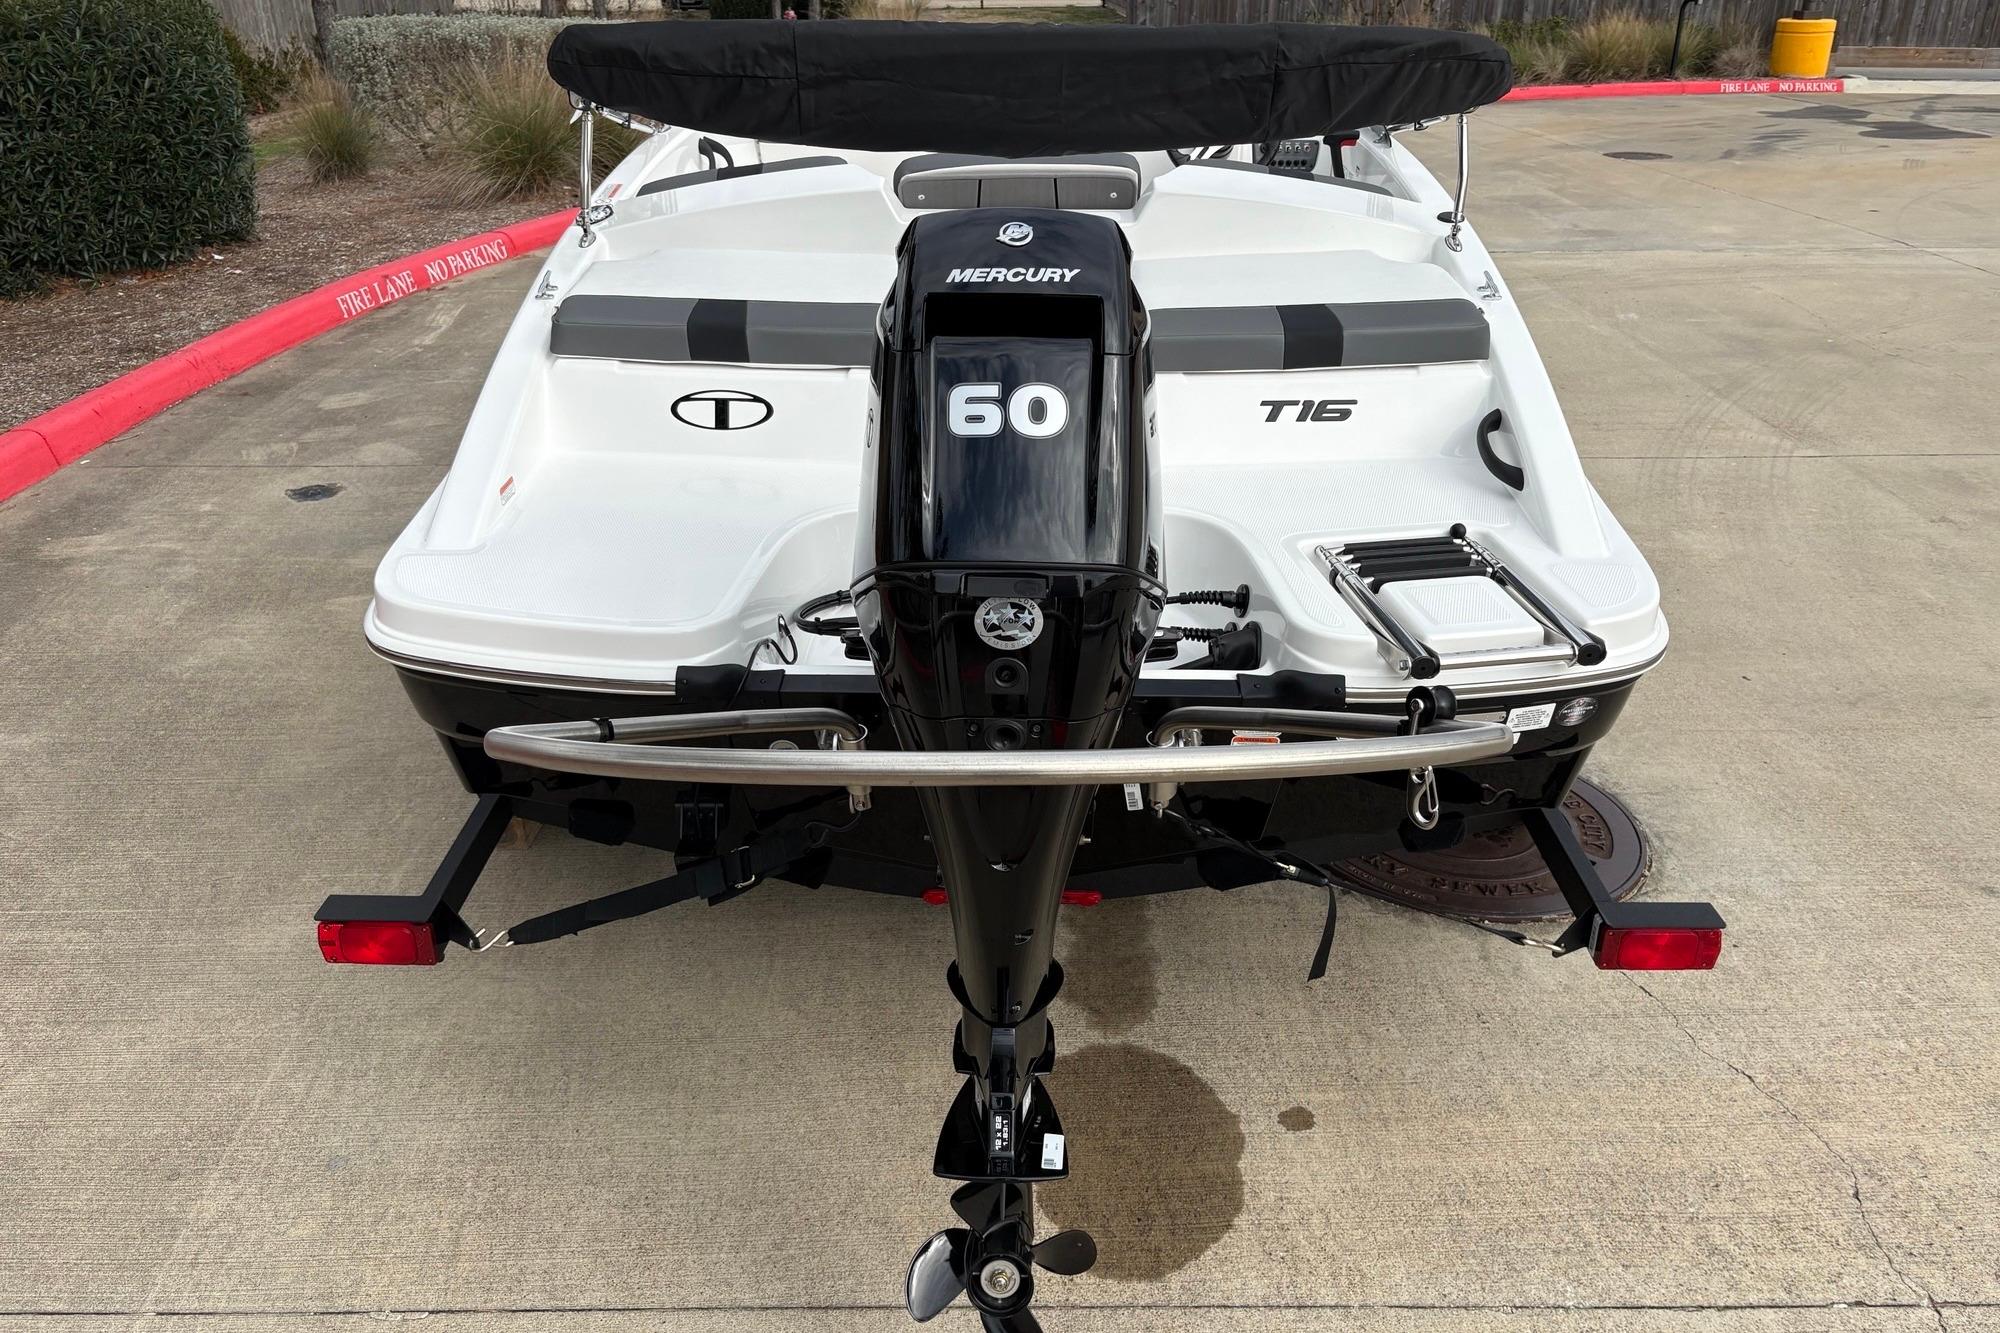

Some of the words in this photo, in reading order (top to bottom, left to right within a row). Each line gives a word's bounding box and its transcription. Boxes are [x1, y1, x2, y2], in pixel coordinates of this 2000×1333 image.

[1720, 80, 1741, 93] FIRE
[1744, 82, 1770, 92] LANE
[1779, 82, 1793, 92] NO
[1795, 82, 1837, 92] PARKING
[336, 286, 375, 319] FIRE
[373, 270, 417, 304] LANE
[424, 259, 449, 284] NO
[447, 239, 507, 276] PARKING
[945, 267, 1081, 283] MERCURY
[947, 382, 1070, 439] 60
[1260, 399, 1358, 422] T16
[1577, 813, 1606, 851] CITY
[1430, 877, 1549, 896] SEWER
[995, 1116, 1002, 1129] 22
[995, 1139, 1002, 1150] 12
